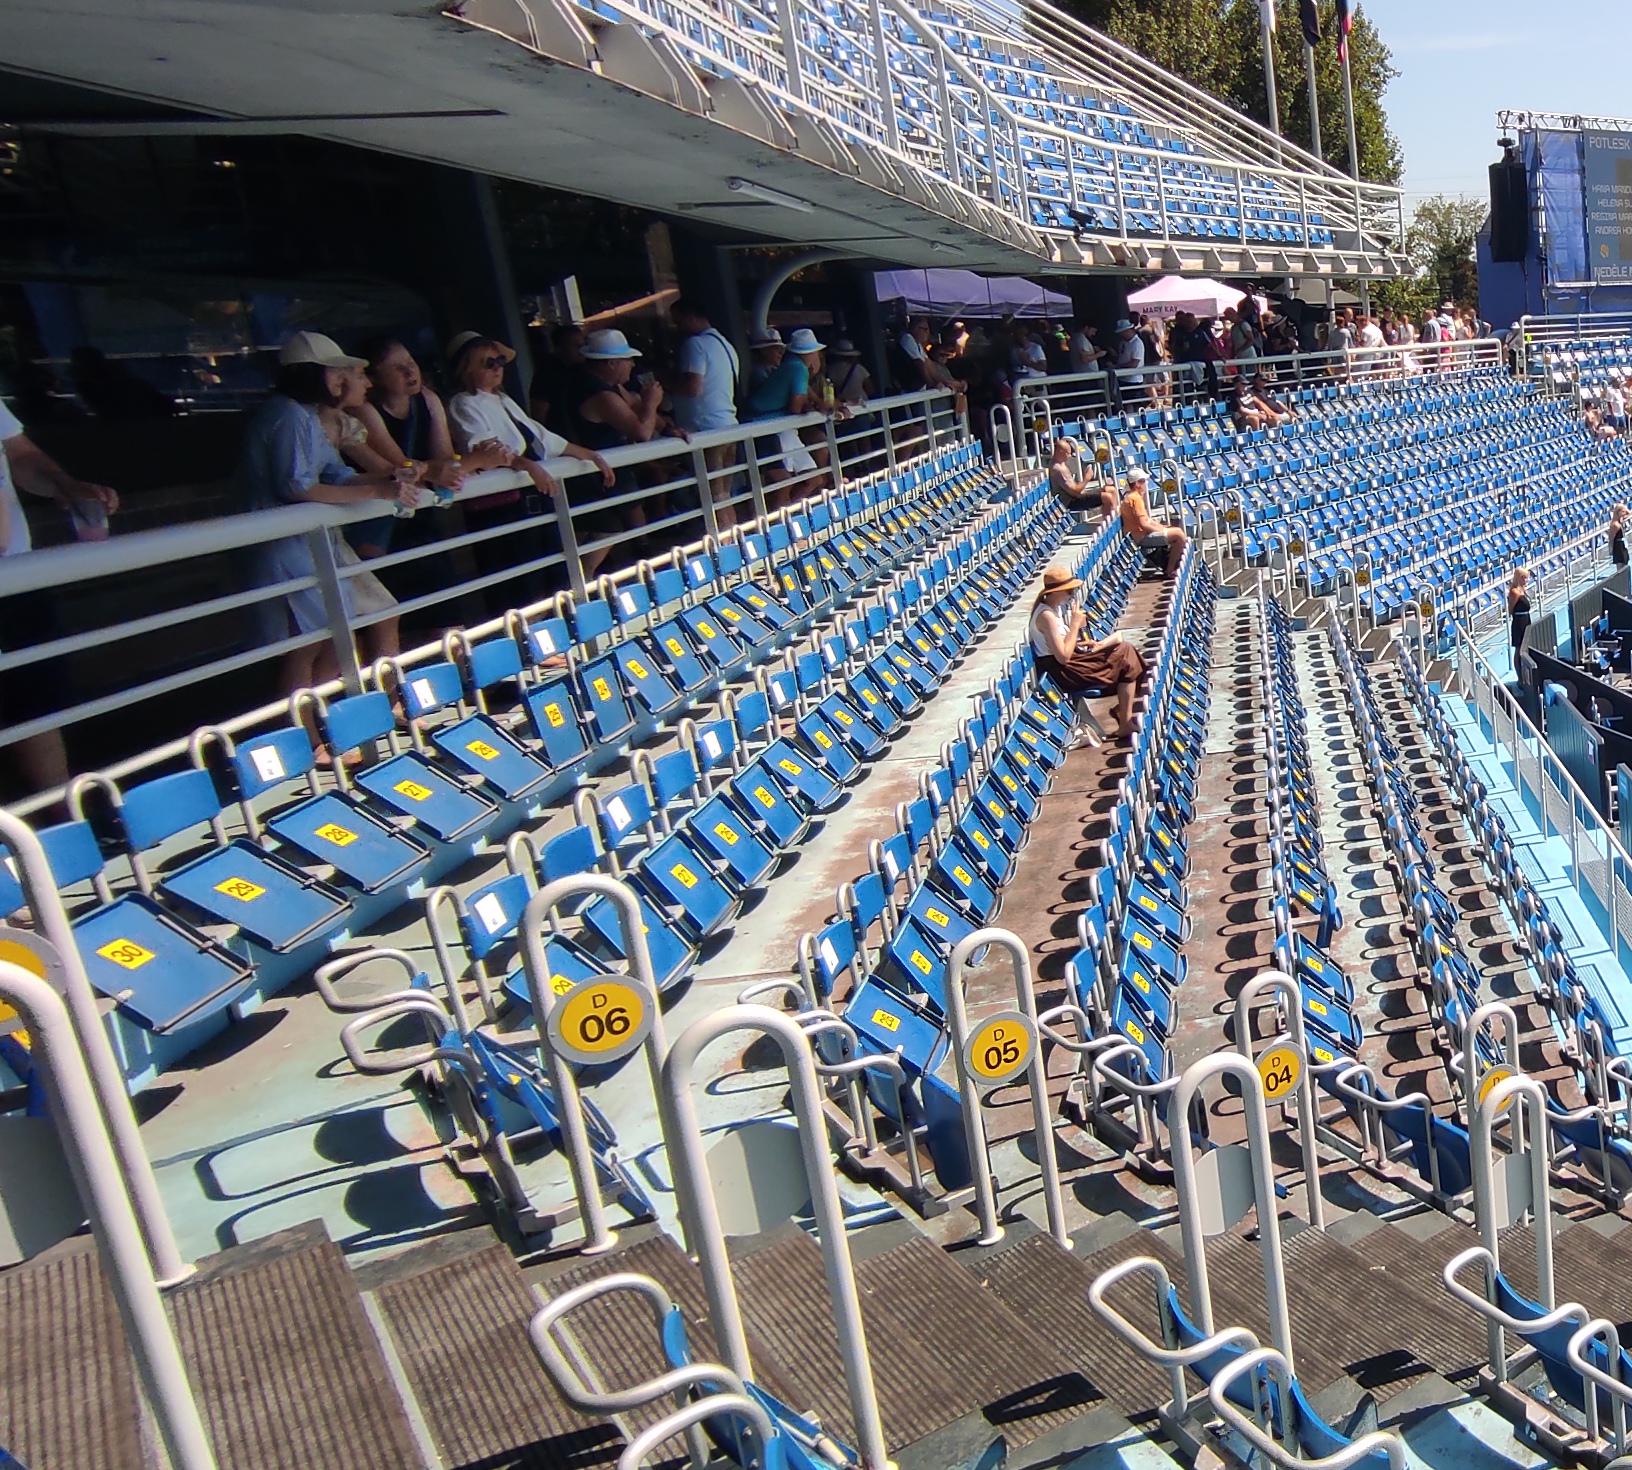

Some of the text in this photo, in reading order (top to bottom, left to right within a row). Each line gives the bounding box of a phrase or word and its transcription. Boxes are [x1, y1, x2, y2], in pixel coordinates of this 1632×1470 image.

[325, 827, 349, 843] 28
[227, 881, 255, 899] 29
[111, 944, 143, 963] 30
[592, 993, 607, 1009] D
[580, 1007, 630, 1043] 06
[993, 1028, 1005, 1042] D
[985, 1038, 1020, 1070] 05
[1272, 1056, 1281, 1068] D
[1265, 1065, 1292, 1092] 04
